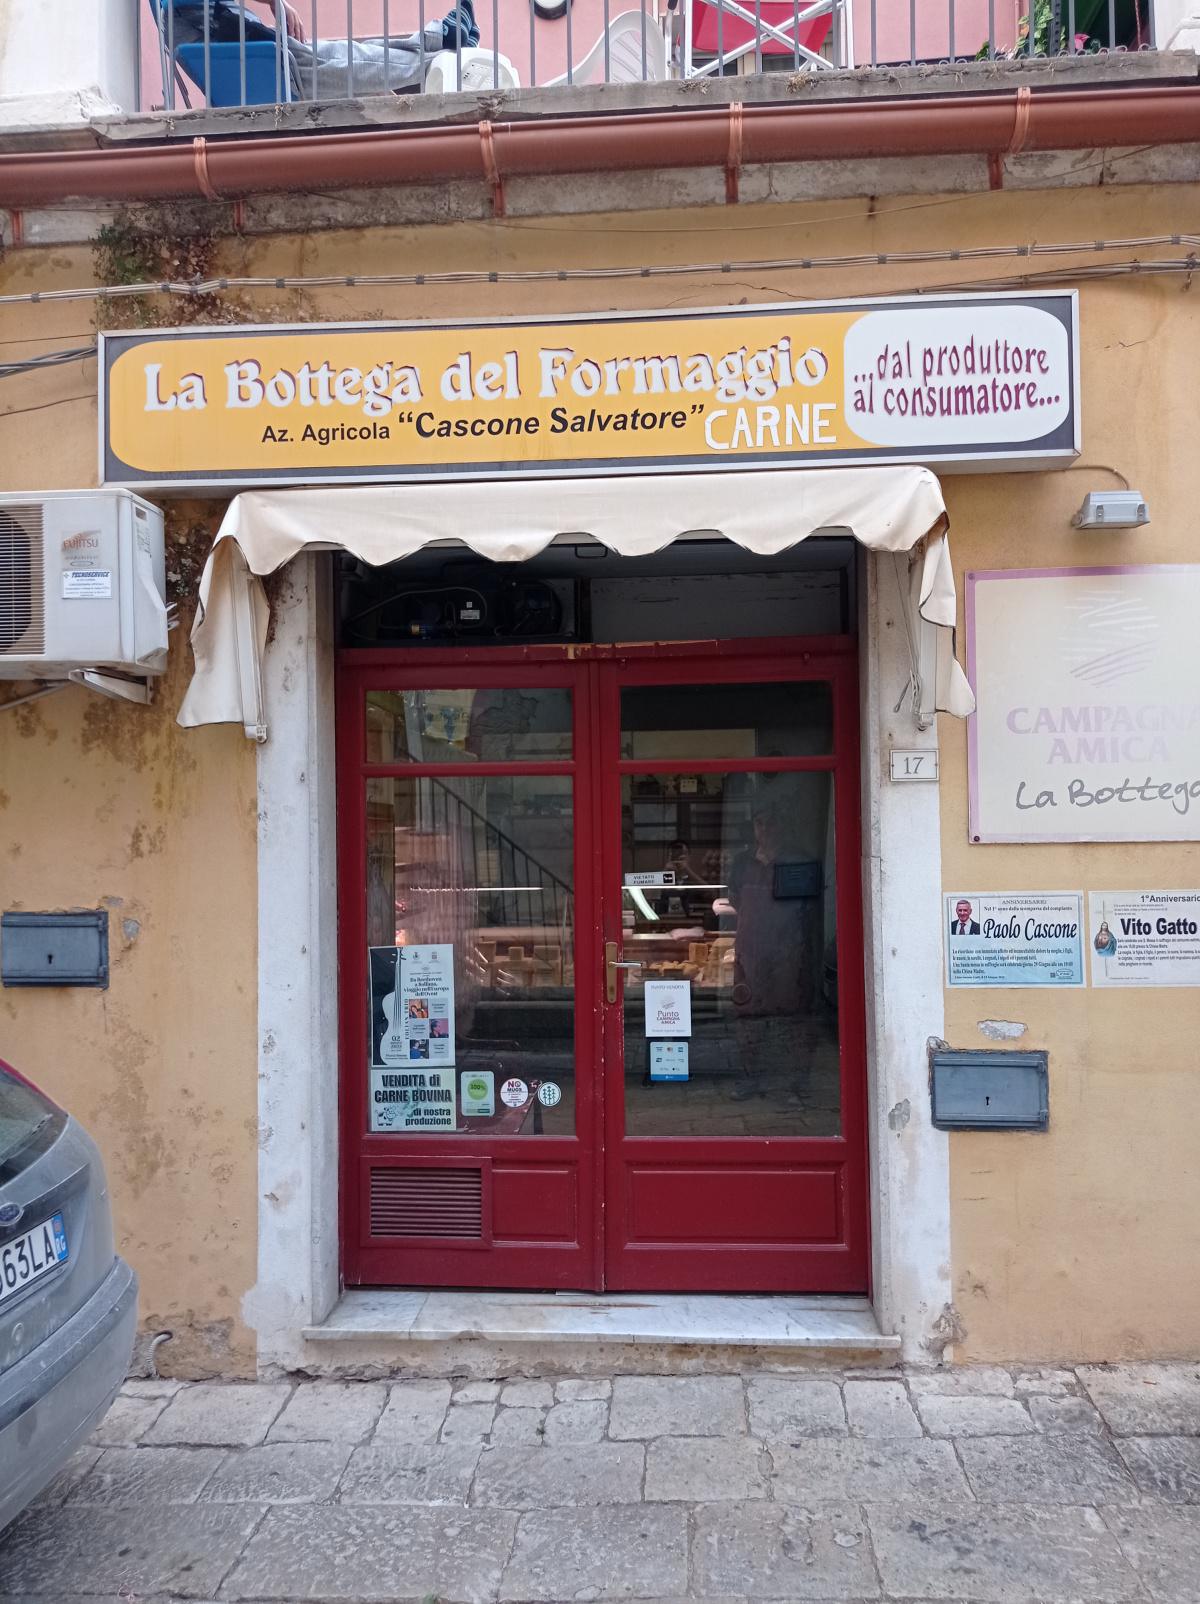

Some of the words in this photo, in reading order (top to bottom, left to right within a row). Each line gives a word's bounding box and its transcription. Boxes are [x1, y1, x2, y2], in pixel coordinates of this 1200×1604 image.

[923, 334, 1049, 386] produttore
[144, 363, 207, 412] La
[224, 358, 423, 417] Bottega
[440, 350, 521, 401] del
[538, 335, 828, 403] Formaggio
[853, 381, 874, 414] al
[884, 377, 1060, 417] consumatore...
[262, 425, 294, 443] Az.
[301, 422, 390, 446] Agricola
[704, 402, 837, 450] CARNE
[63, 538, 99, 549] FUJITSU
[1047, 736, 1171, 765] AMICA
[903, 757, 923, 775] 17
[1015, 781, 1057, 810] La
[983, 915, 1021, 939] Paolo
[1024, 918, 1077, 941] Cascone
[1120, 918, 1152, 936] Vito
[1156, 917, 1198, 935] Gatto
[381, 1074, 426, 1087] VENDITA
[429, 1073, 441, 1087] di
[507, 1080, 522, 1088] NO
[374, 1090, 409, 1103] CARNE
[412, 1089, 453, 1103] BOVINA
[405, 1117, 452, 1126] produzione
[412, 1108, 421, 1116] di
[423, 1108, 451, 1116] nostra
[0, 1226, 55, 1296] 63LA
